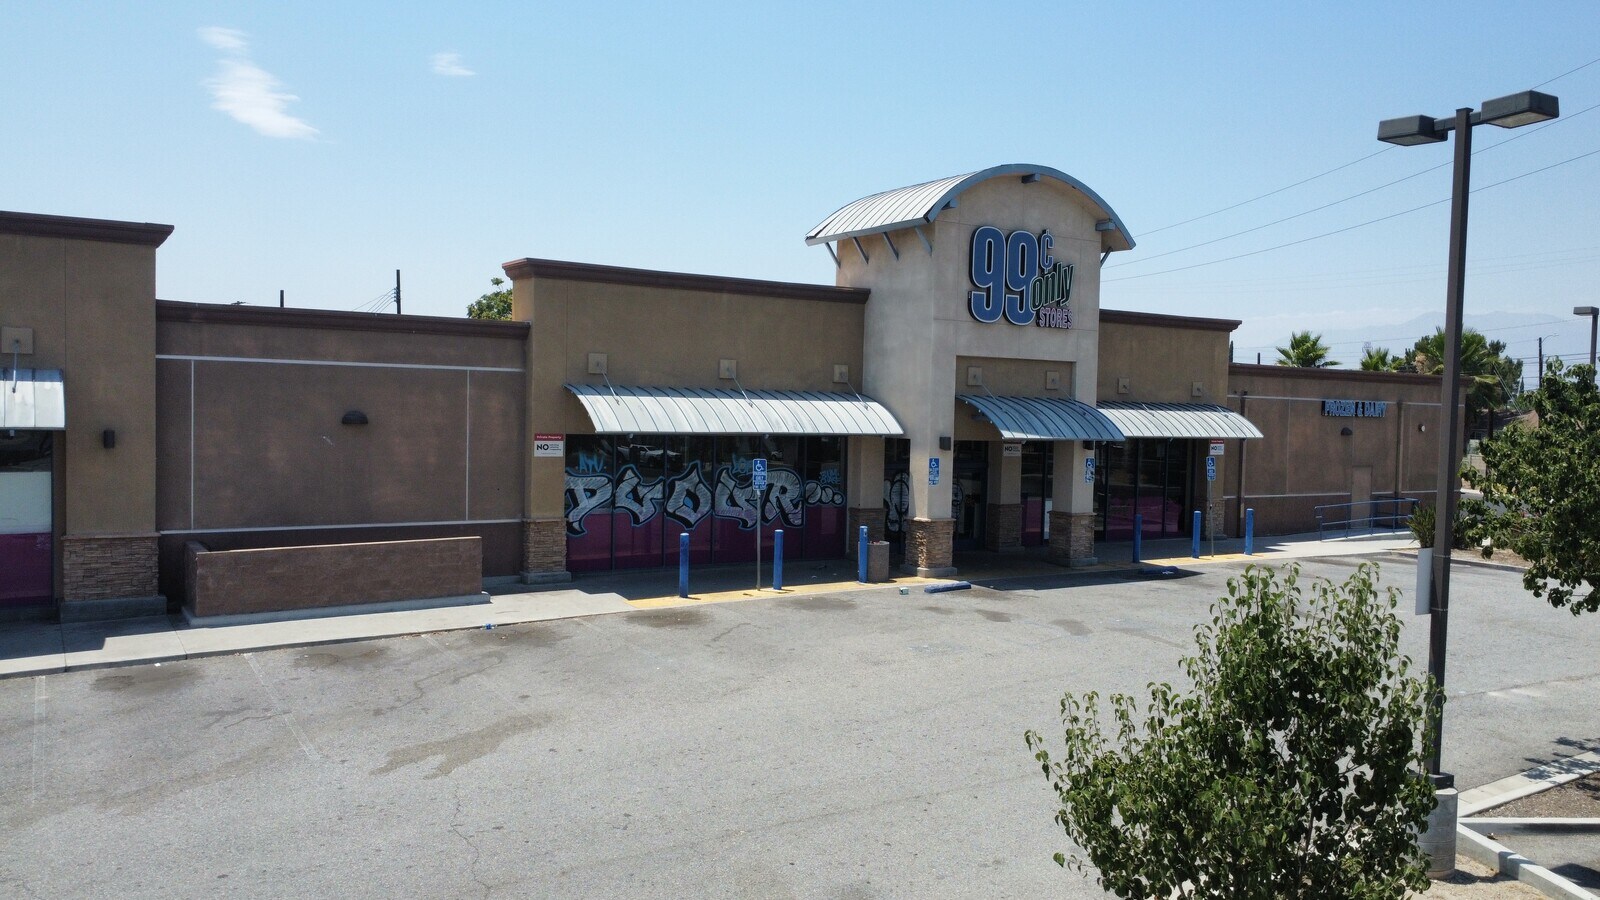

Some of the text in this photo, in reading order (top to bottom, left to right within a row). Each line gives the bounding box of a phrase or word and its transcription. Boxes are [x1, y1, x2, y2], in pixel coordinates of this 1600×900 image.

[1030, 262, 1075, 311] only
[1039, 307, 1073, 329] STORES
[1323, 400, 1387, 417] FROZEN & DAIRY
[536, 443, 549, 451] NO
